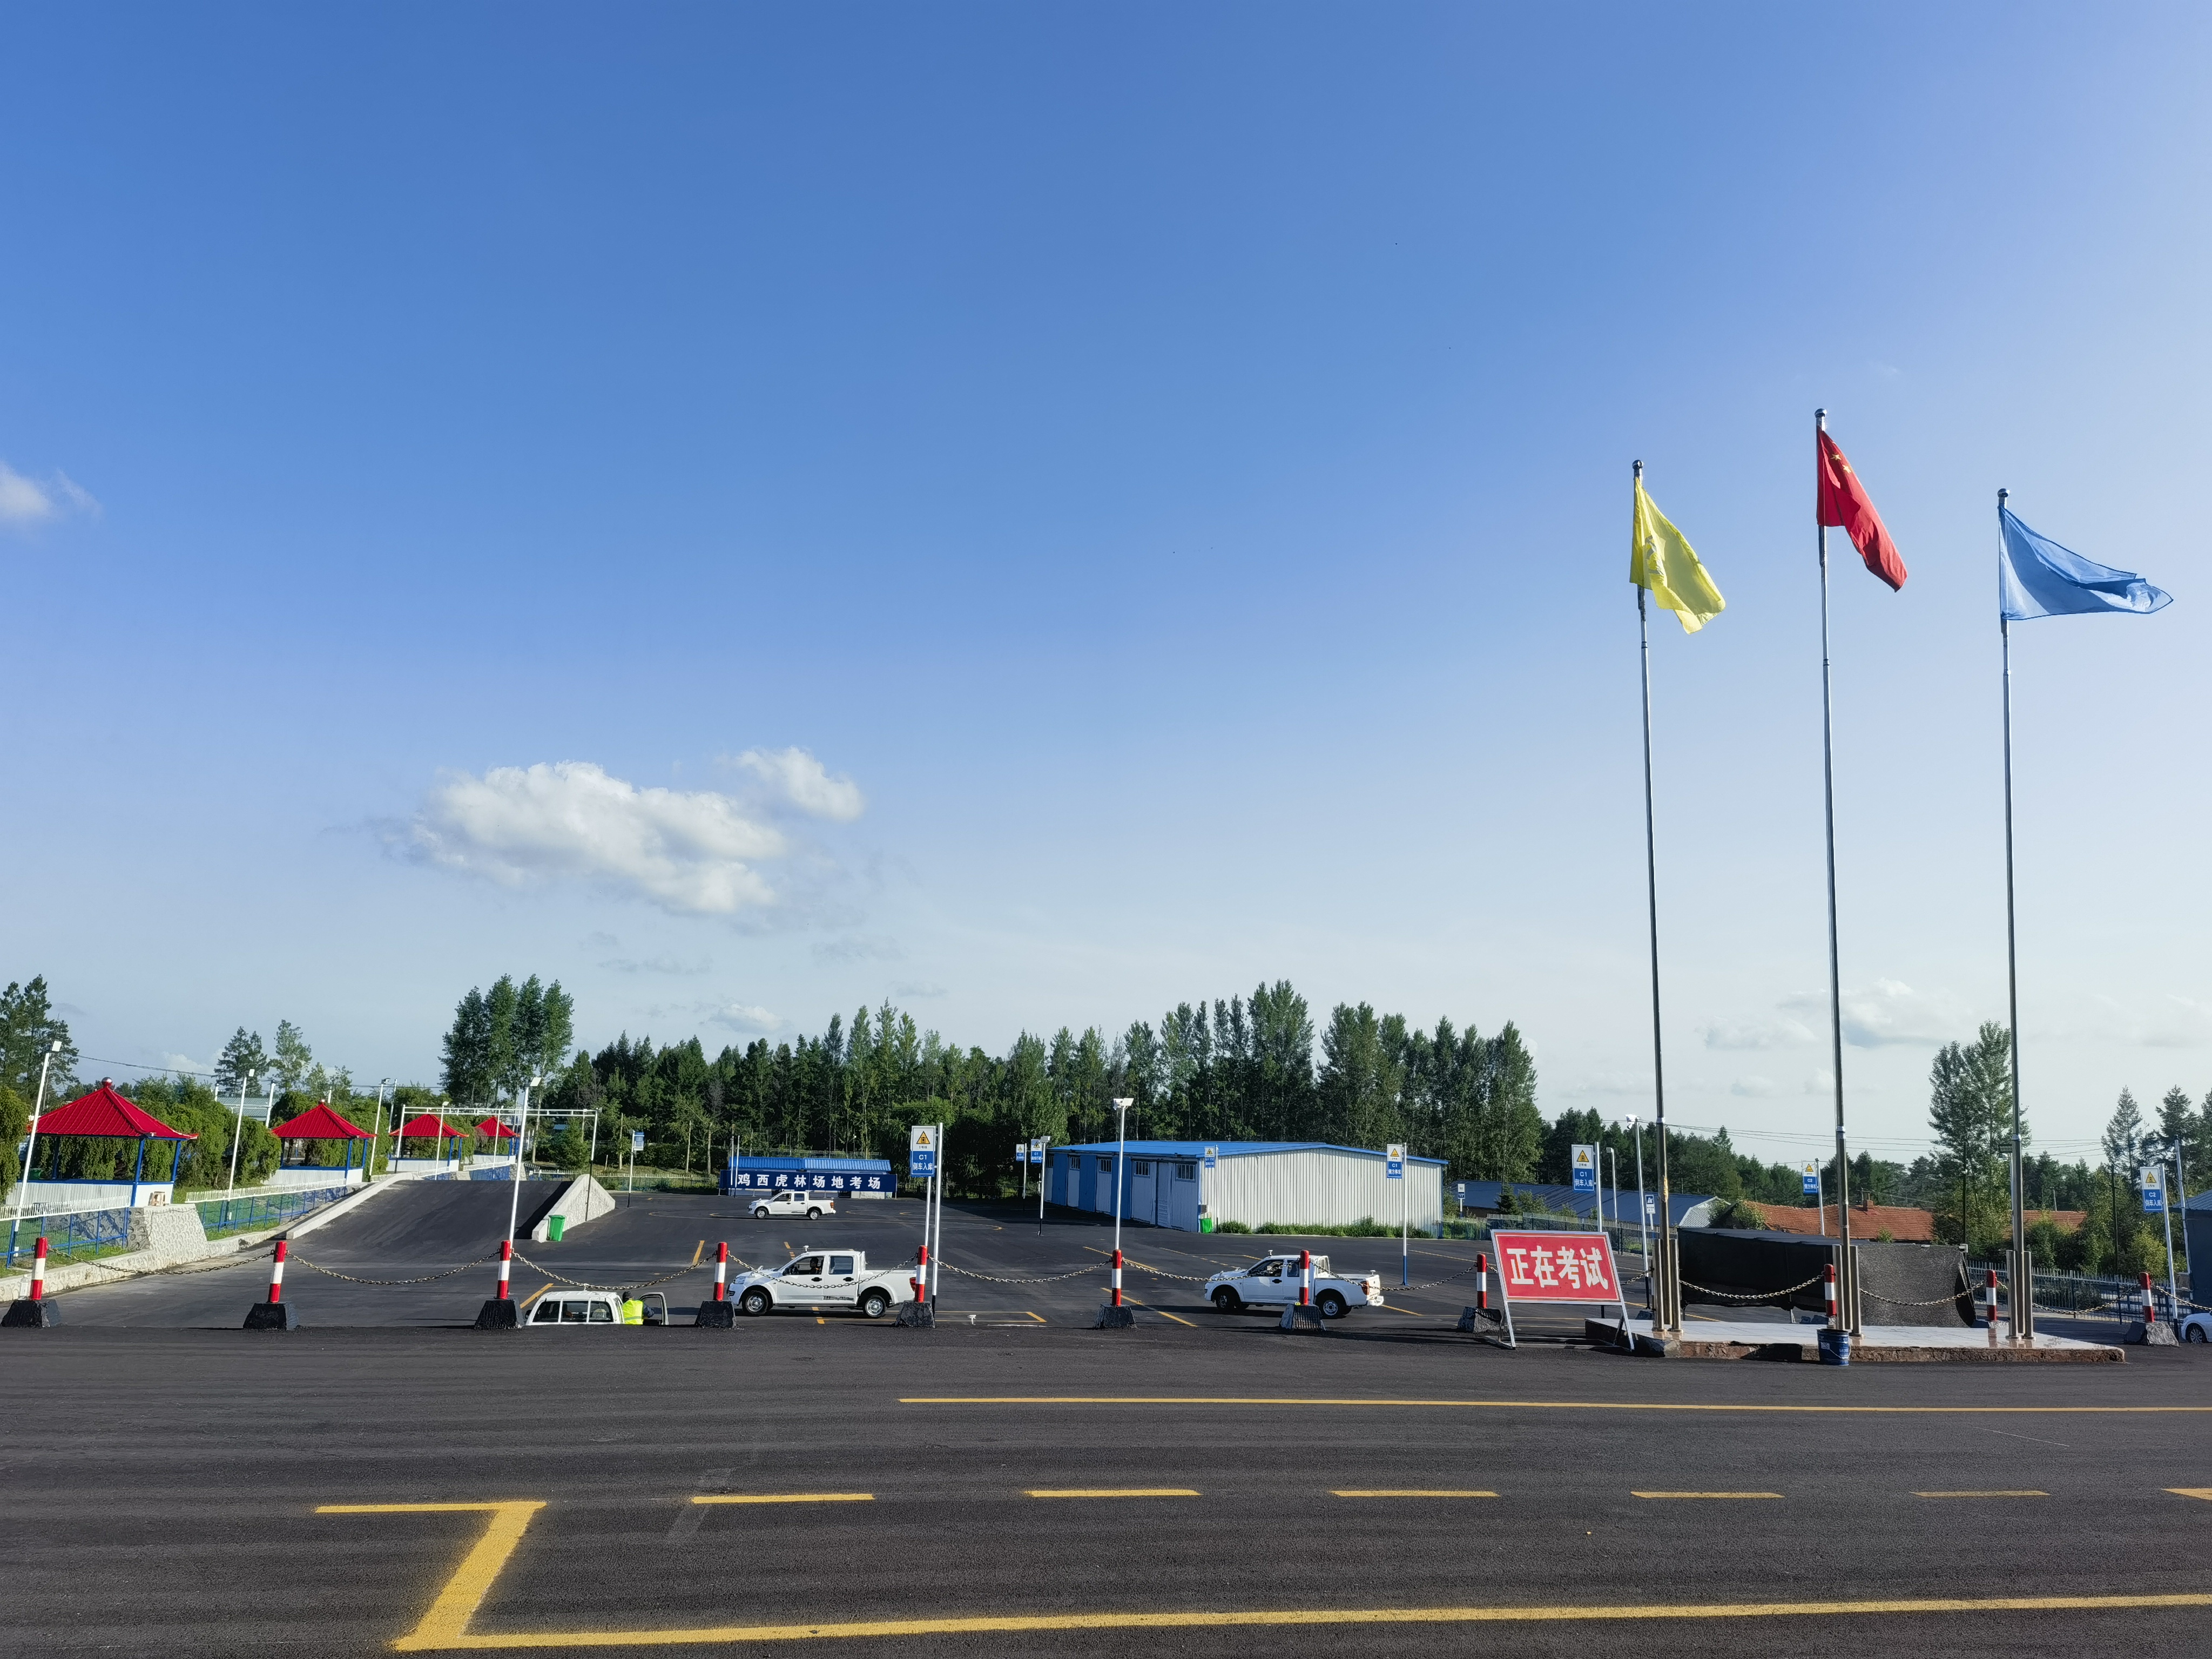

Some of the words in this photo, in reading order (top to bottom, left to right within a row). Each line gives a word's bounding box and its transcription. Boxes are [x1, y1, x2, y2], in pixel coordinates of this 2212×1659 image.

[913, 1162, 933, 1171] 倒车入库
[738, 1173, 881, 1190] 鸡西虎林场地考场
[1575, 1178, 1593, 1187] 倒车入库
[2144, 1199, 2161, 1207] 倒车入库
[1506, 1245, 1609, 1290] 正在考试
